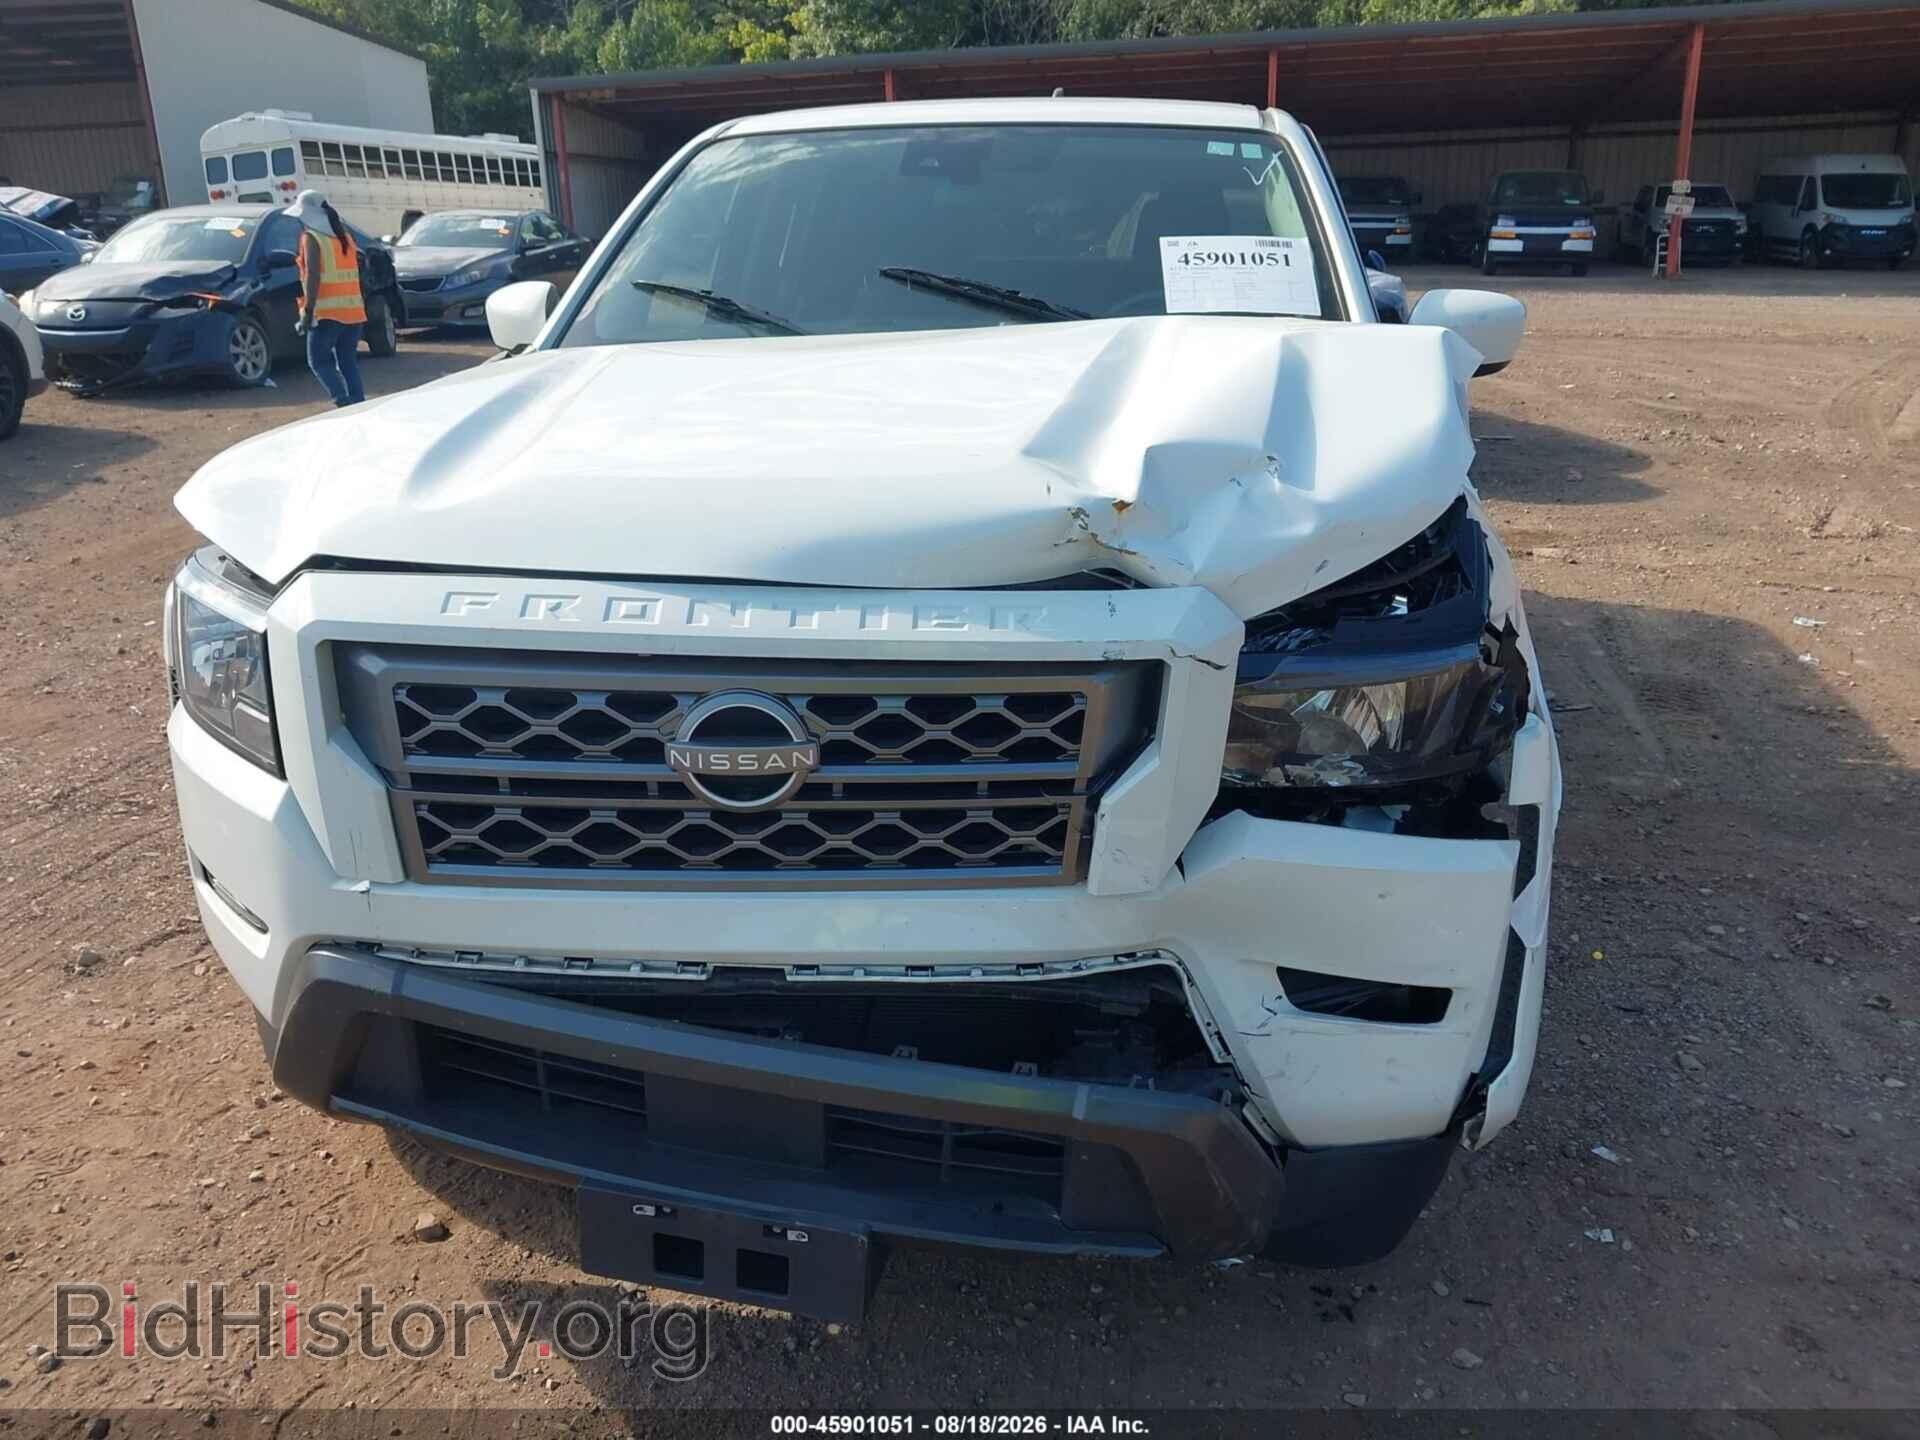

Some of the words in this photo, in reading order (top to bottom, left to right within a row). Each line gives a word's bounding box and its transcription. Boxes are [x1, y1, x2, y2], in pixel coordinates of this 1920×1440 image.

[1177, 251, 1292, 268] 45901051
[439, 591, 1051, 632] FRONTIER
[669, 749, 814, 771] NISSAN
